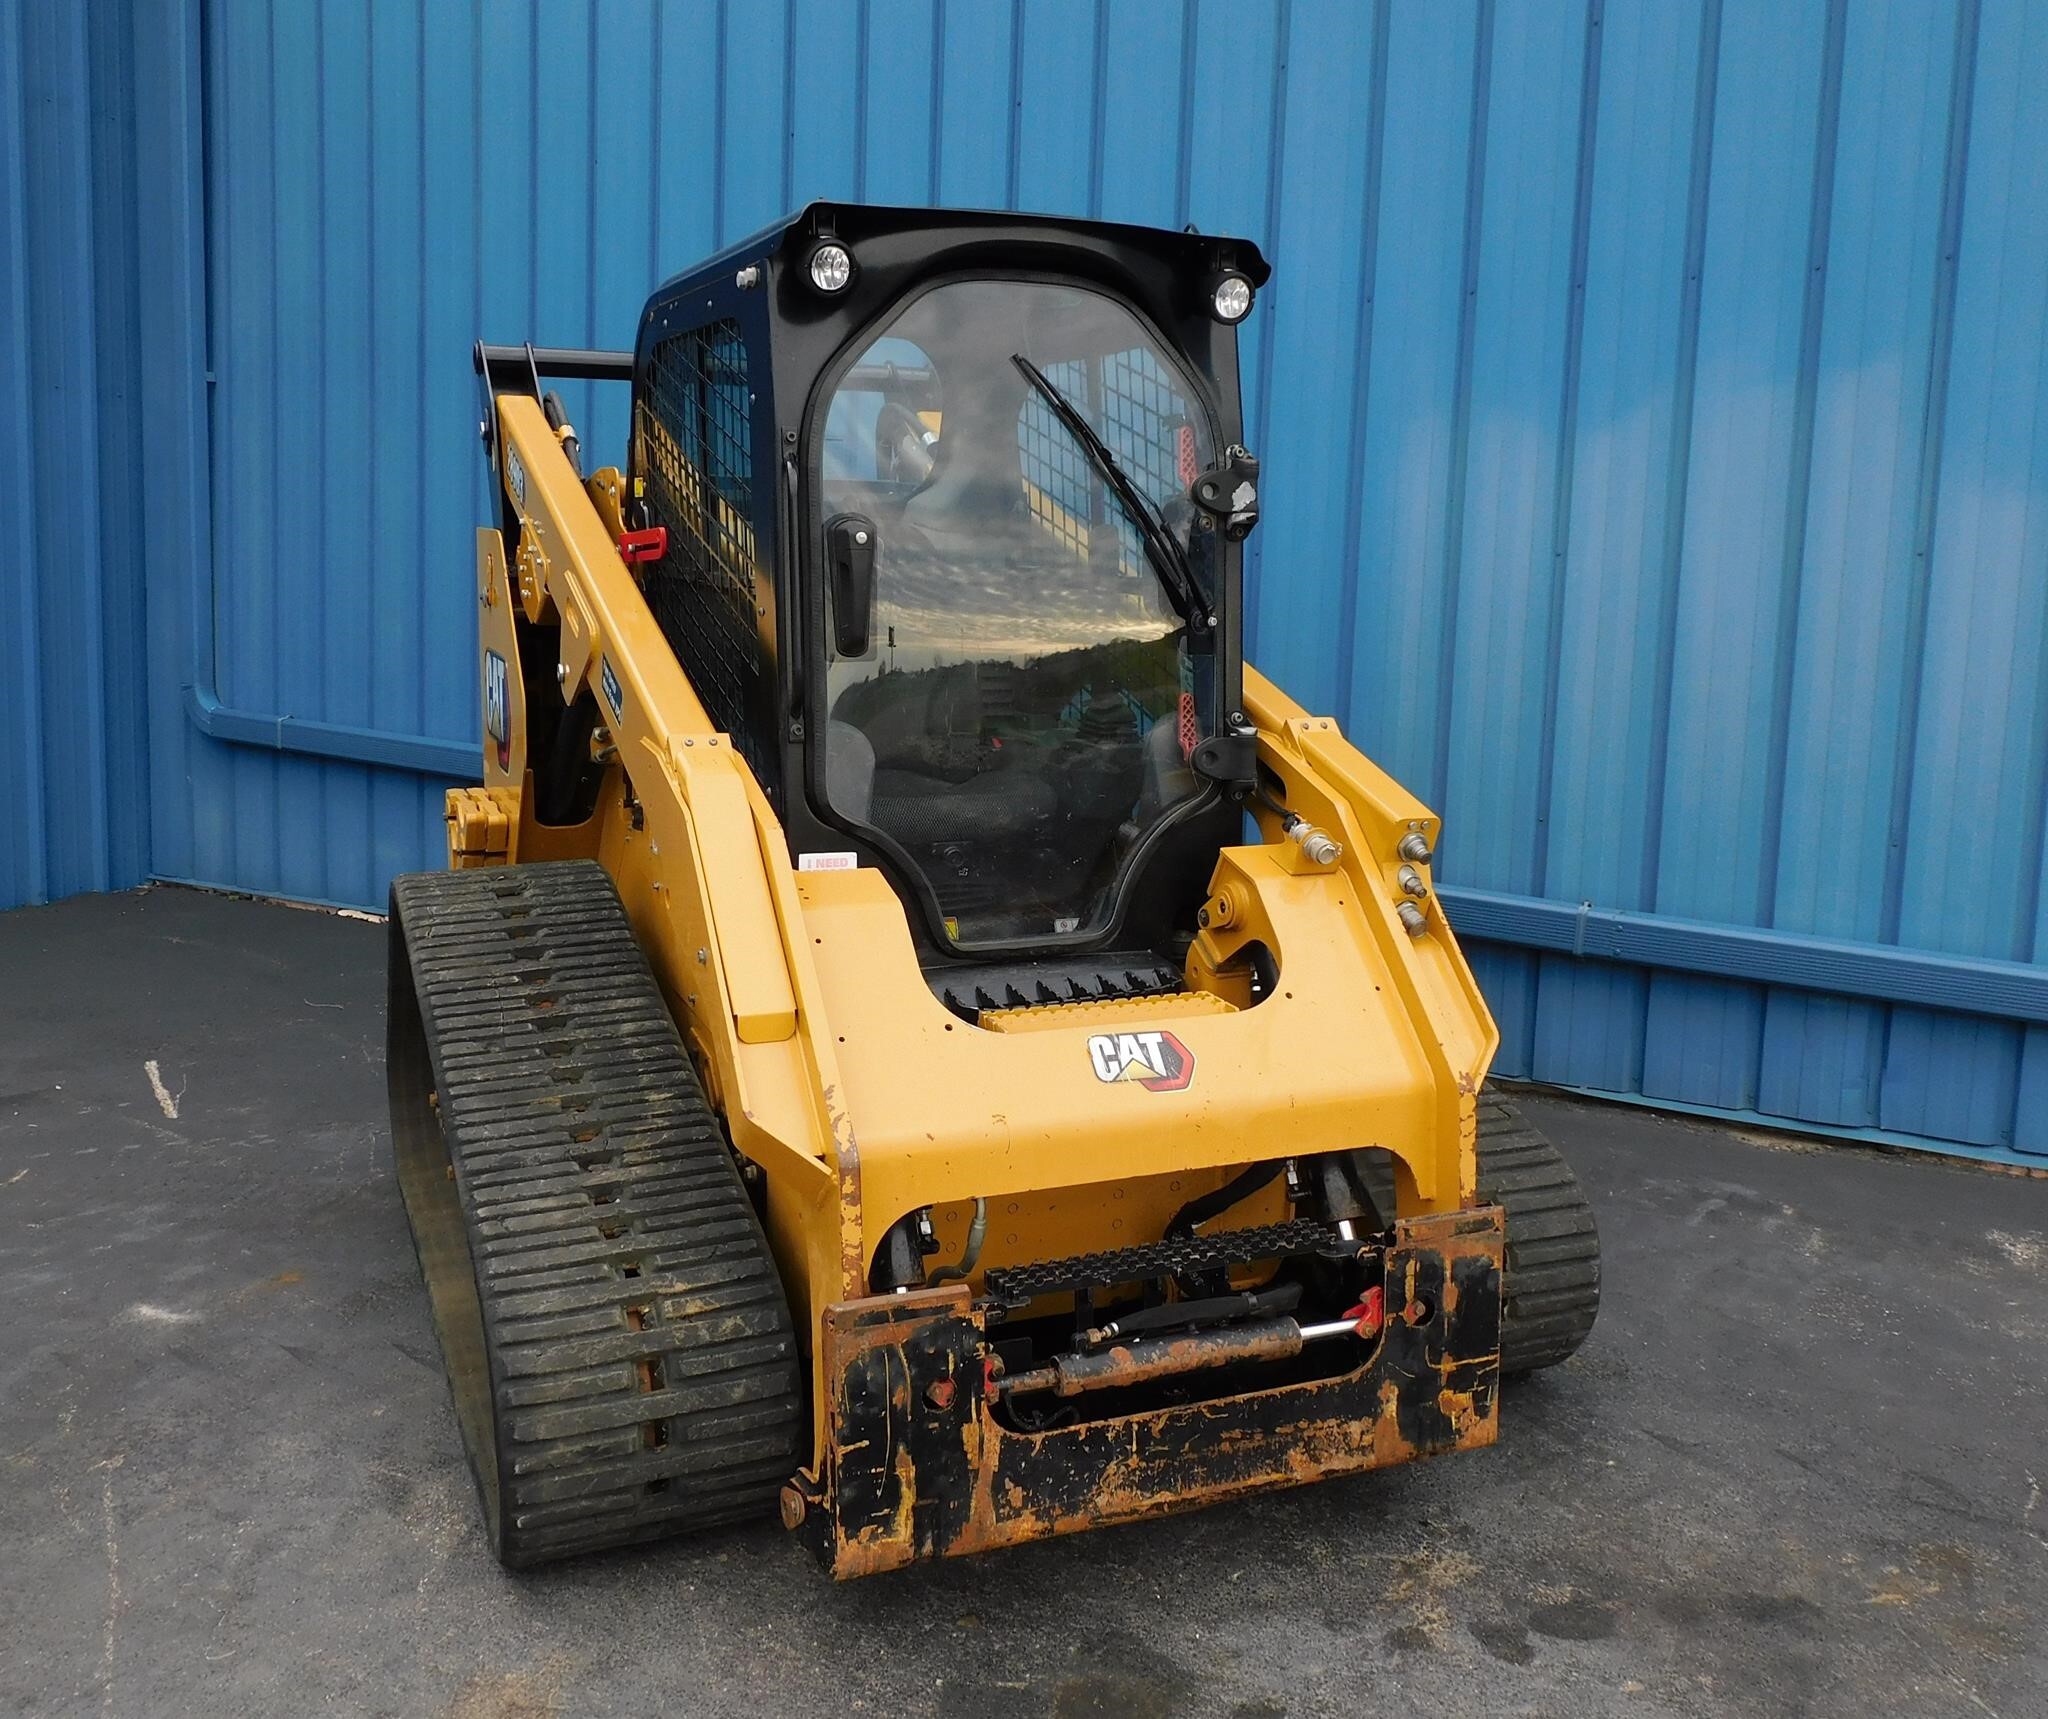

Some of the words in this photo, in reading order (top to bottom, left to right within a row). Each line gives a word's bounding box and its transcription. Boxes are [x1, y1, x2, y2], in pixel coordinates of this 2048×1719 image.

[485, 651, 505, 742] CAT
[816, 858, 848, 868] NEED
[1088, 1032, 1167, 1081] CAT
